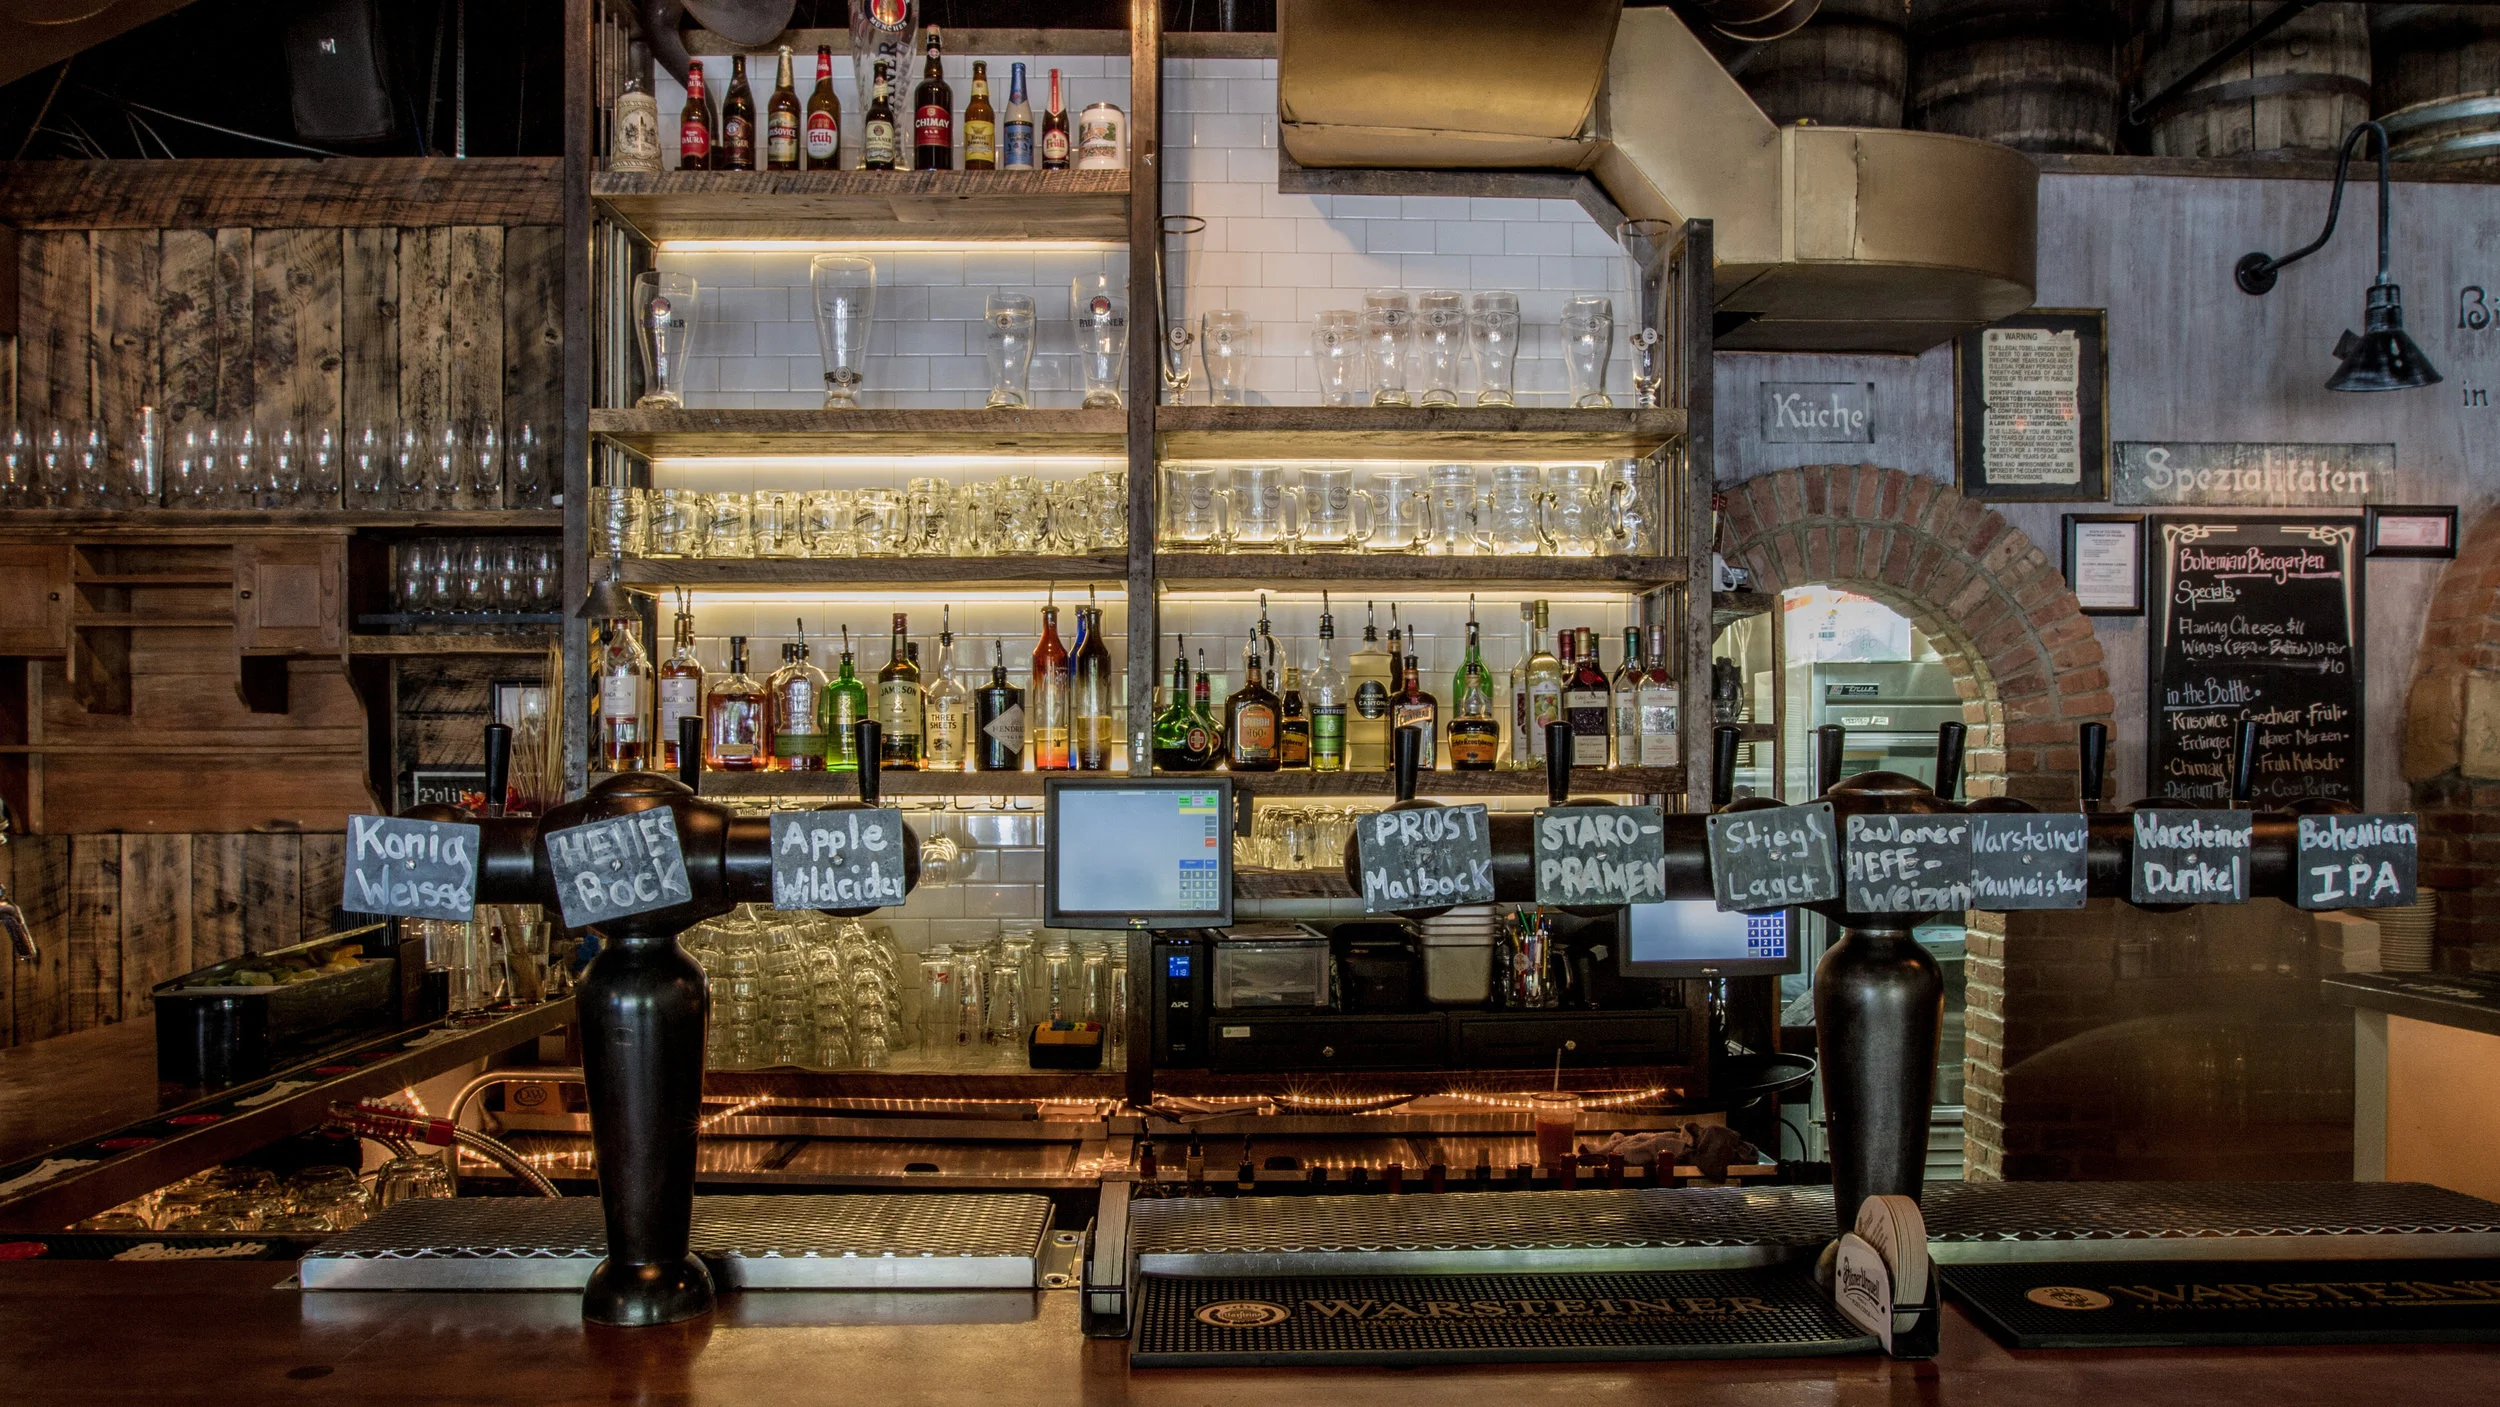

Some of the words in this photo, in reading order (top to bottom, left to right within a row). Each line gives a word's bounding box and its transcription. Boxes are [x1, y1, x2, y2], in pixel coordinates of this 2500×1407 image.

[808, 131, 833, 145] früh
[915, 119, 950, 129] CHIMAY
[2004, 332, 2038, 341] WARNING
[2463, 380, 2489, 407] in
[1773, 392, 1864, 437] Küche
[2142, 446, 2370, 496] Spezialitäten
[2180, 548, 2246, 573] Bohemian
[2246, 547, 2325, 585] Biergarten
[2179, 616, 2228, 641] Flaming
[2230, 615, 2285, 636] Cheese
[2181, 640, 2223, 659] Wings
[2167, 687, 2179, 705] in
[2182, 681, 2207, 705] the
[2205, 677, 2254, 705] Bottle
[929, 721, 957, 730] SHEETS
[931, 714, 955, 722] THREE
[2308, 702, 2342, 727] Früli
[1248, 728, 1264, 738] 160
[2181, 734, 2233, 760] Erdinger
[2295, 728, 2342, 747] Marzen
[2170, 757, 2227, 783] Chimay
[781, 813, 888, 861] Apple
[1376, 806, 1485, 846] PROST
[1541, 814, 1662, 850] STARO-
[1726, 813, 1828, 858] Stiegl
[1847, 815, 1969, 845] Paulaner
[1971, 820, 2088, 853] Warsteiner
[2134, 811, 2253, 851] Warsteiner
[2298, 816, 2418, 852] Bohemian
[1540, 856, 1666, 901] PRAMEN
[1847, 847, 1943, 883] HEFE-
[2143, 855, 2241, 901] Dunkel
[355, 864, 472, 913] Weisse
[777, 861, 906, 903] Wildcider
[1728, 872, 1820, 902] Lager
[1970, 869, 2088, 899] Braumeister
[2310, 861, 2401, 903] IPA
[1302, 1297, 1782, 1318] WARSTEINER
[1358, 1319, 1454, 1327] PREMIUM
